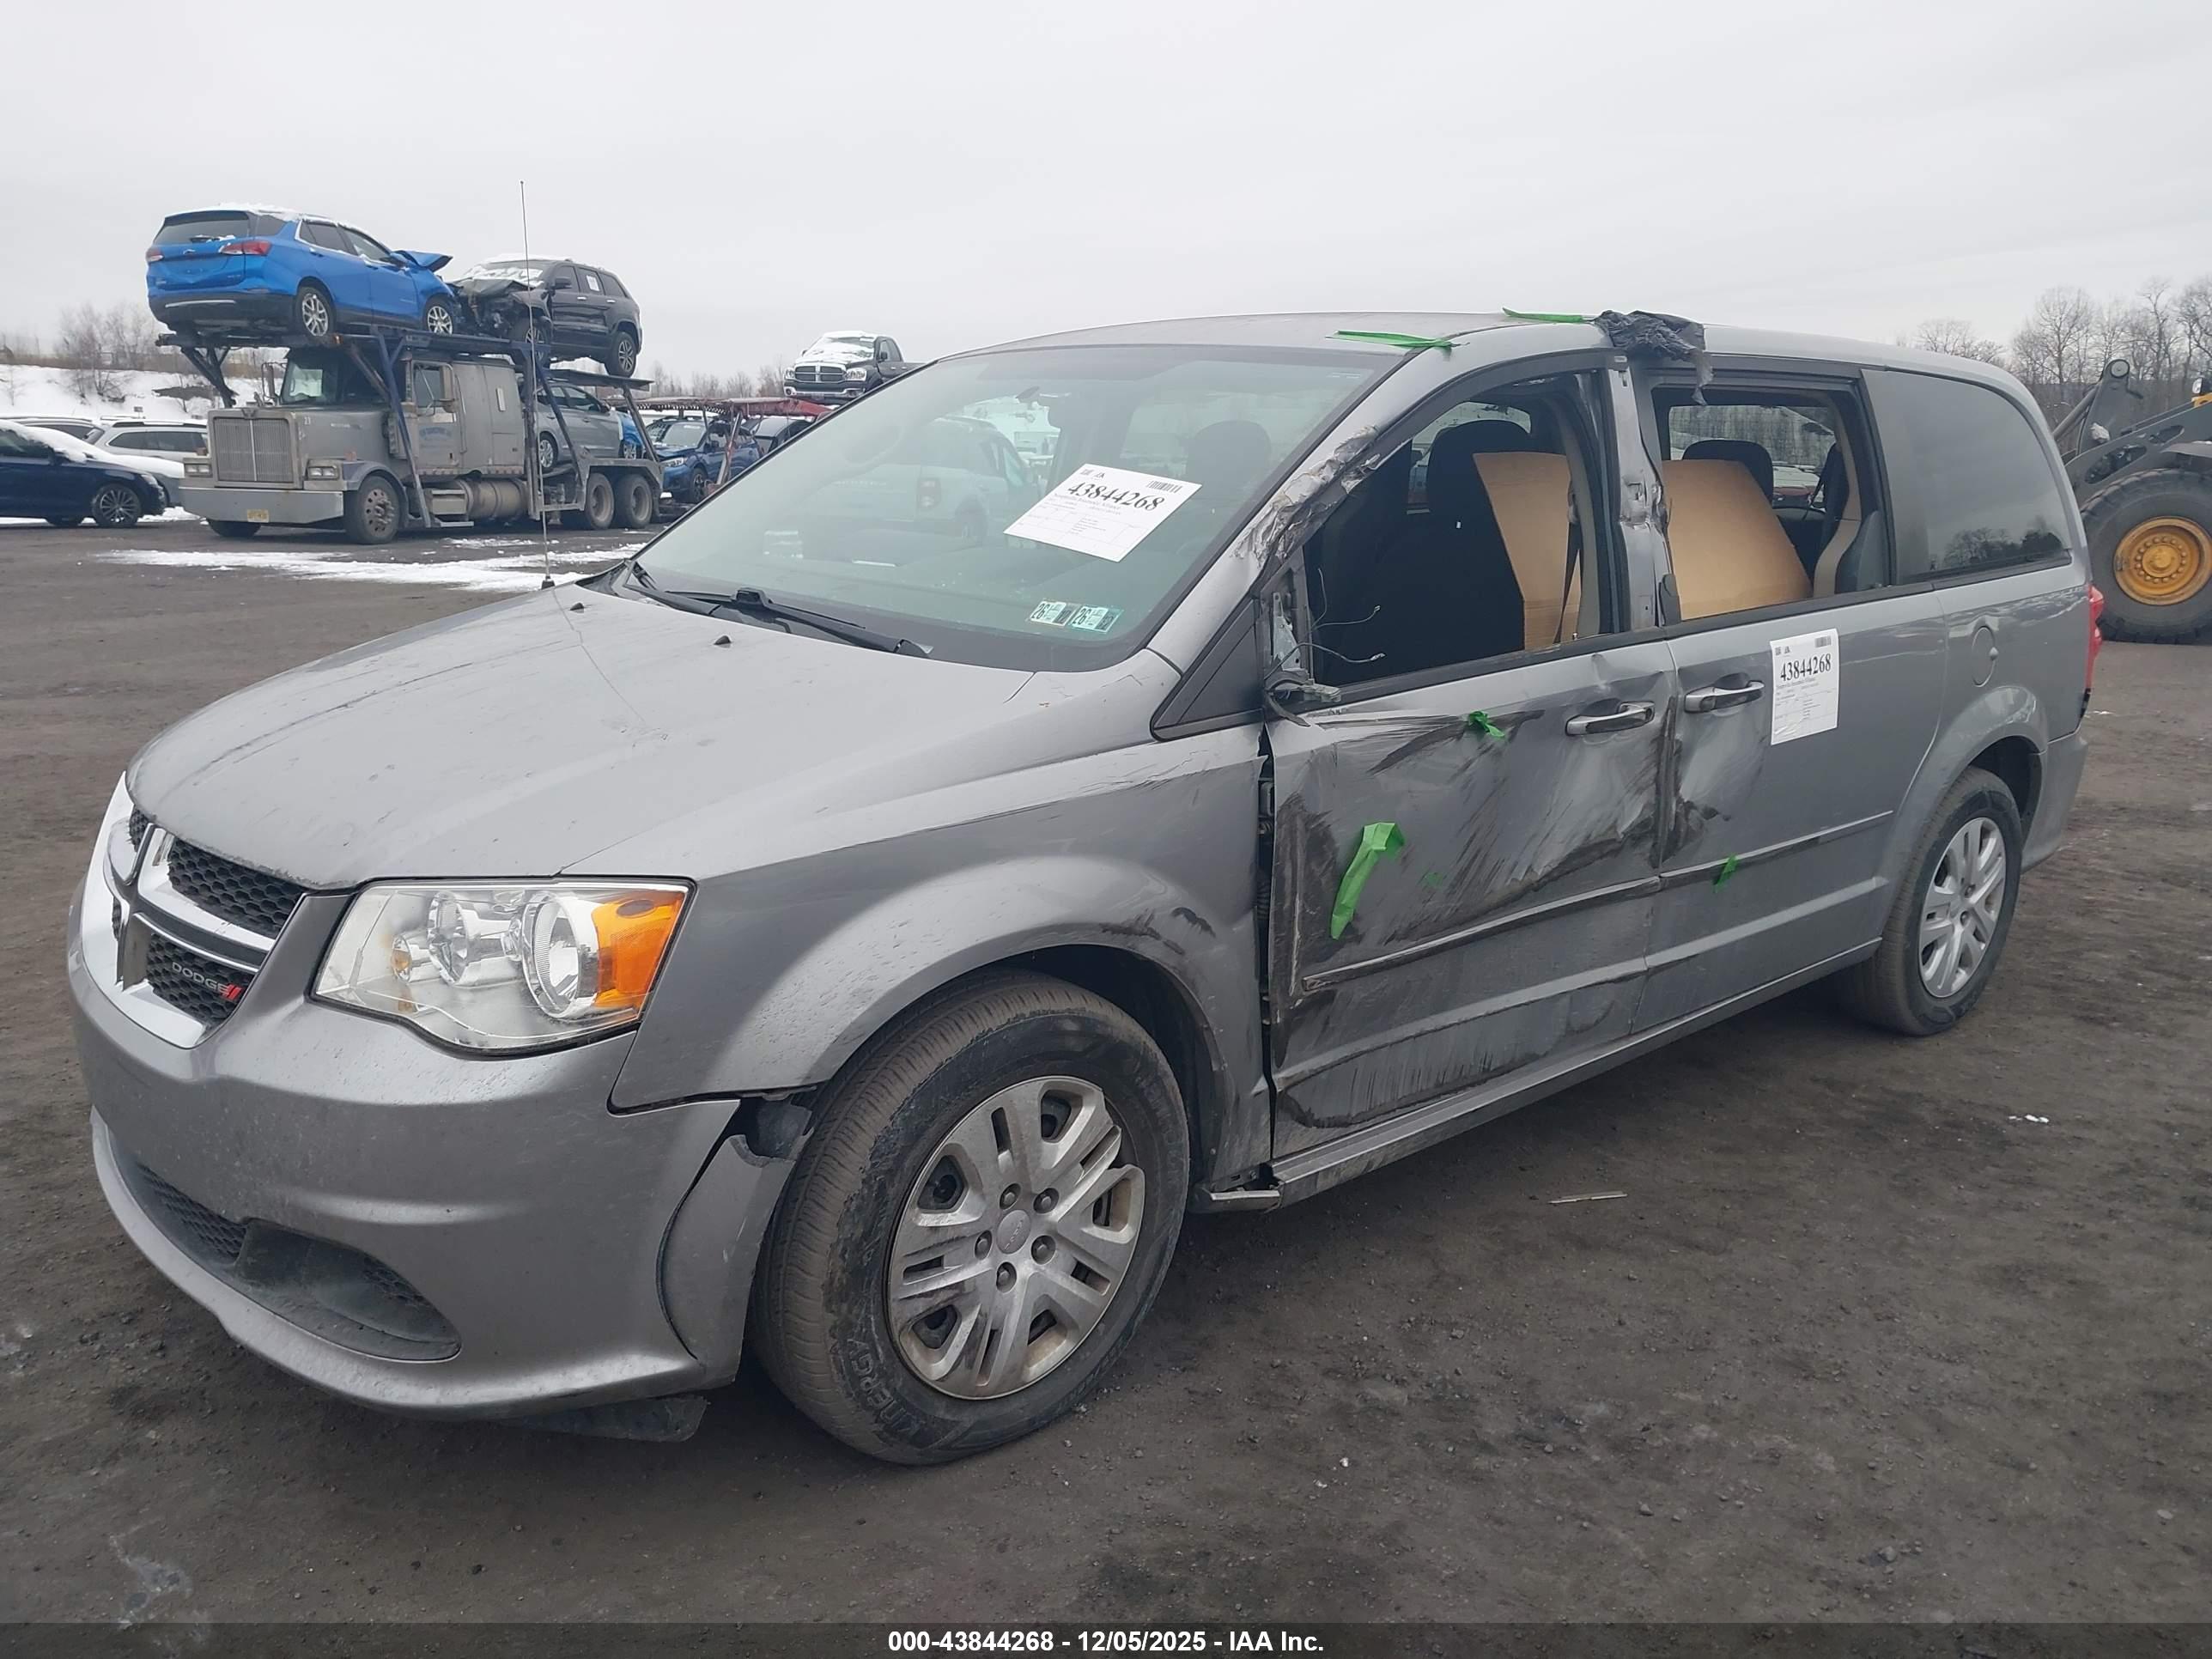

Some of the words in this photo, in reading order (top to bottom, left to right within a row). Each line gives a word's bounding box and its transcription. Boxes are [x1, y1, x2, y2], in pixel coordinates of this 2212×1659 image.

[1067, 482, 1165, 511] 43844268
[1030, 604, 1050, 619] 26
[1072, 608, 1092, 624] 26
[1780, 653, 1832, 682] 43844268
[173, 963, 228, 997] DODGE
